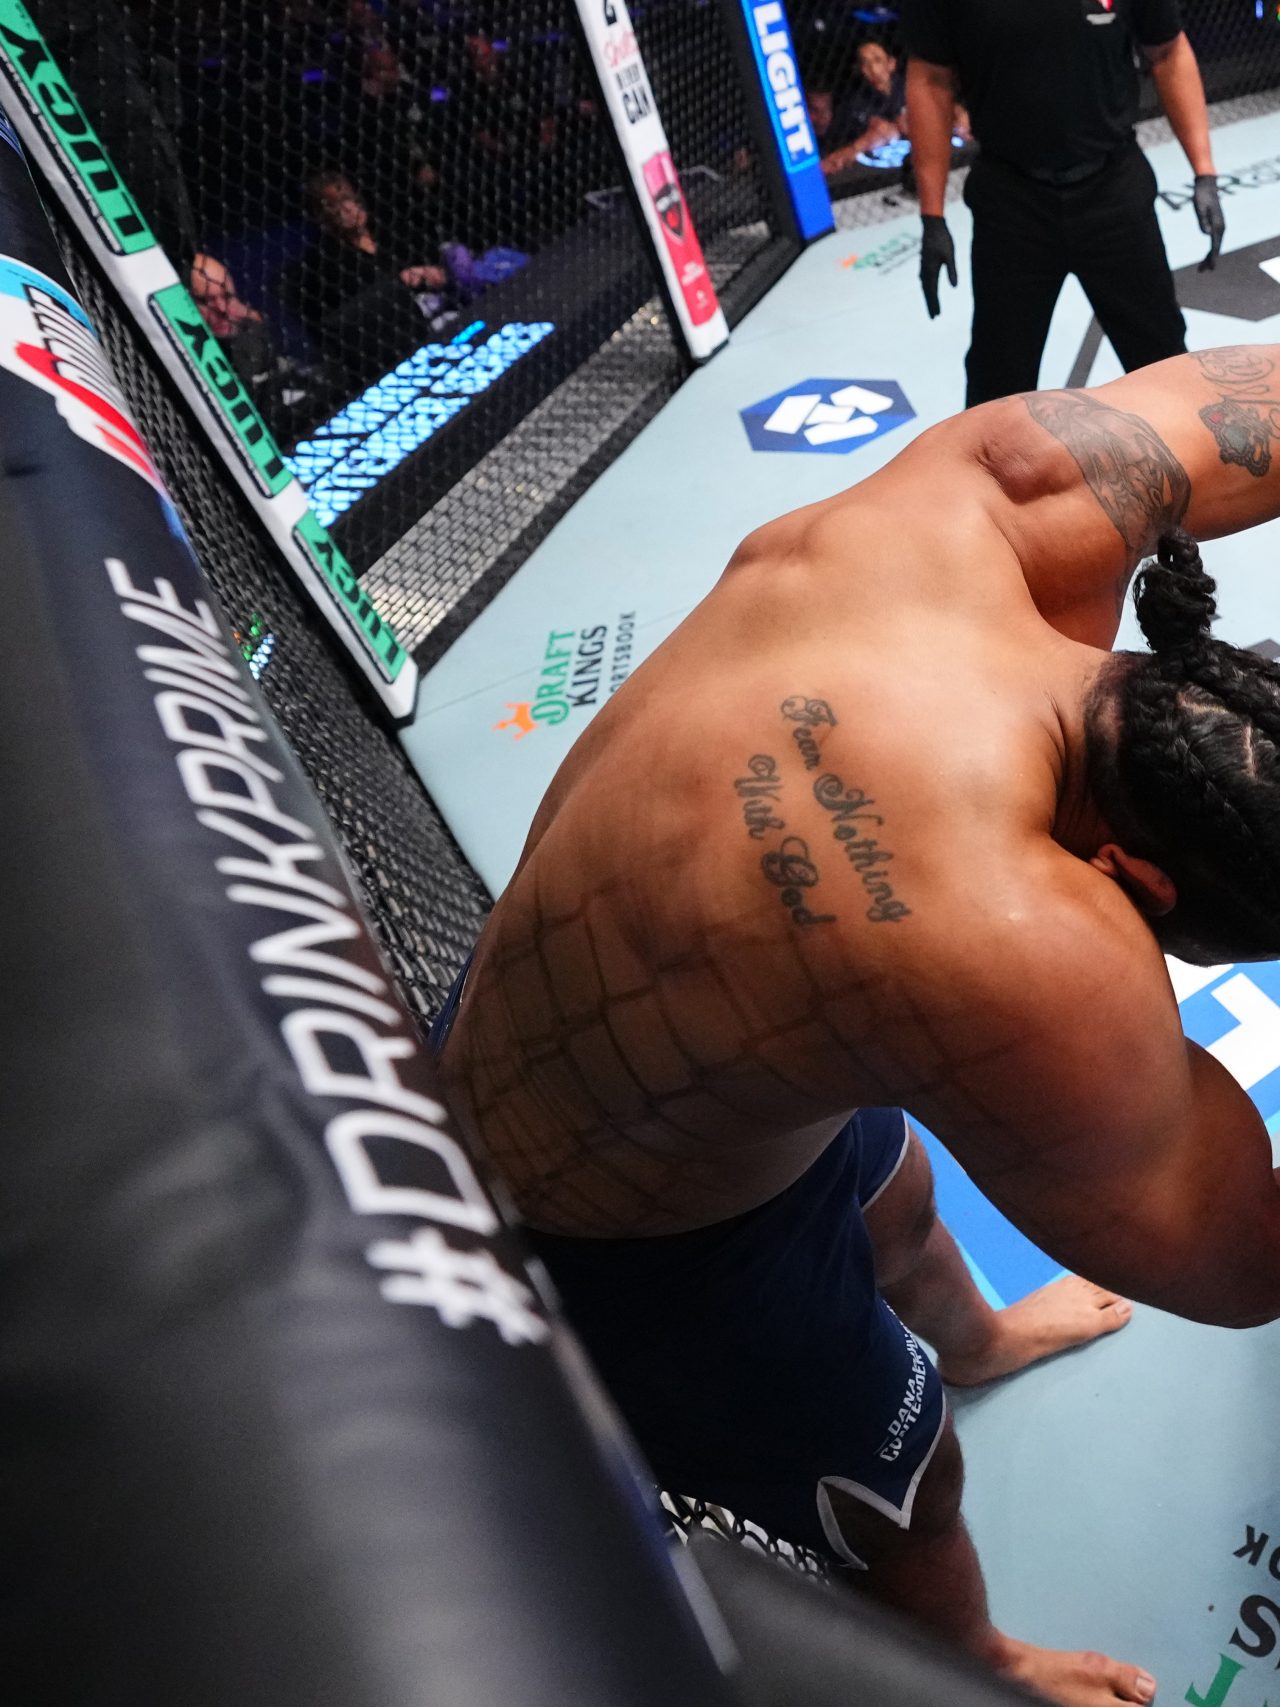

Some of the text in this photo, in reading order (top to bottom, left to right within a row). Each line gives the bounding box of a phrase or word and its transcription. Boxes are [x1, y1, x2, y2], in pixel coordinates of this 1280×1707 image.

[0, 22, 147, 238] LUCY
[753, 1, 814, 155] LIGHT
[176, 316, 287, 481] LUCY
[313, 540, 400, 668] LUCY
[529, 630, 576, 727] DRAFT
[565, 624, 608, 708] KINGS
[609, 611, 637, 693] ORTSBOOK
[733, 753, 838, 928] With God
[813, 772, 913, 923] Nothing
[103, 557, 549, 1346] #DRINKPRIME
[887, 1377, 916, 1437] DANA
